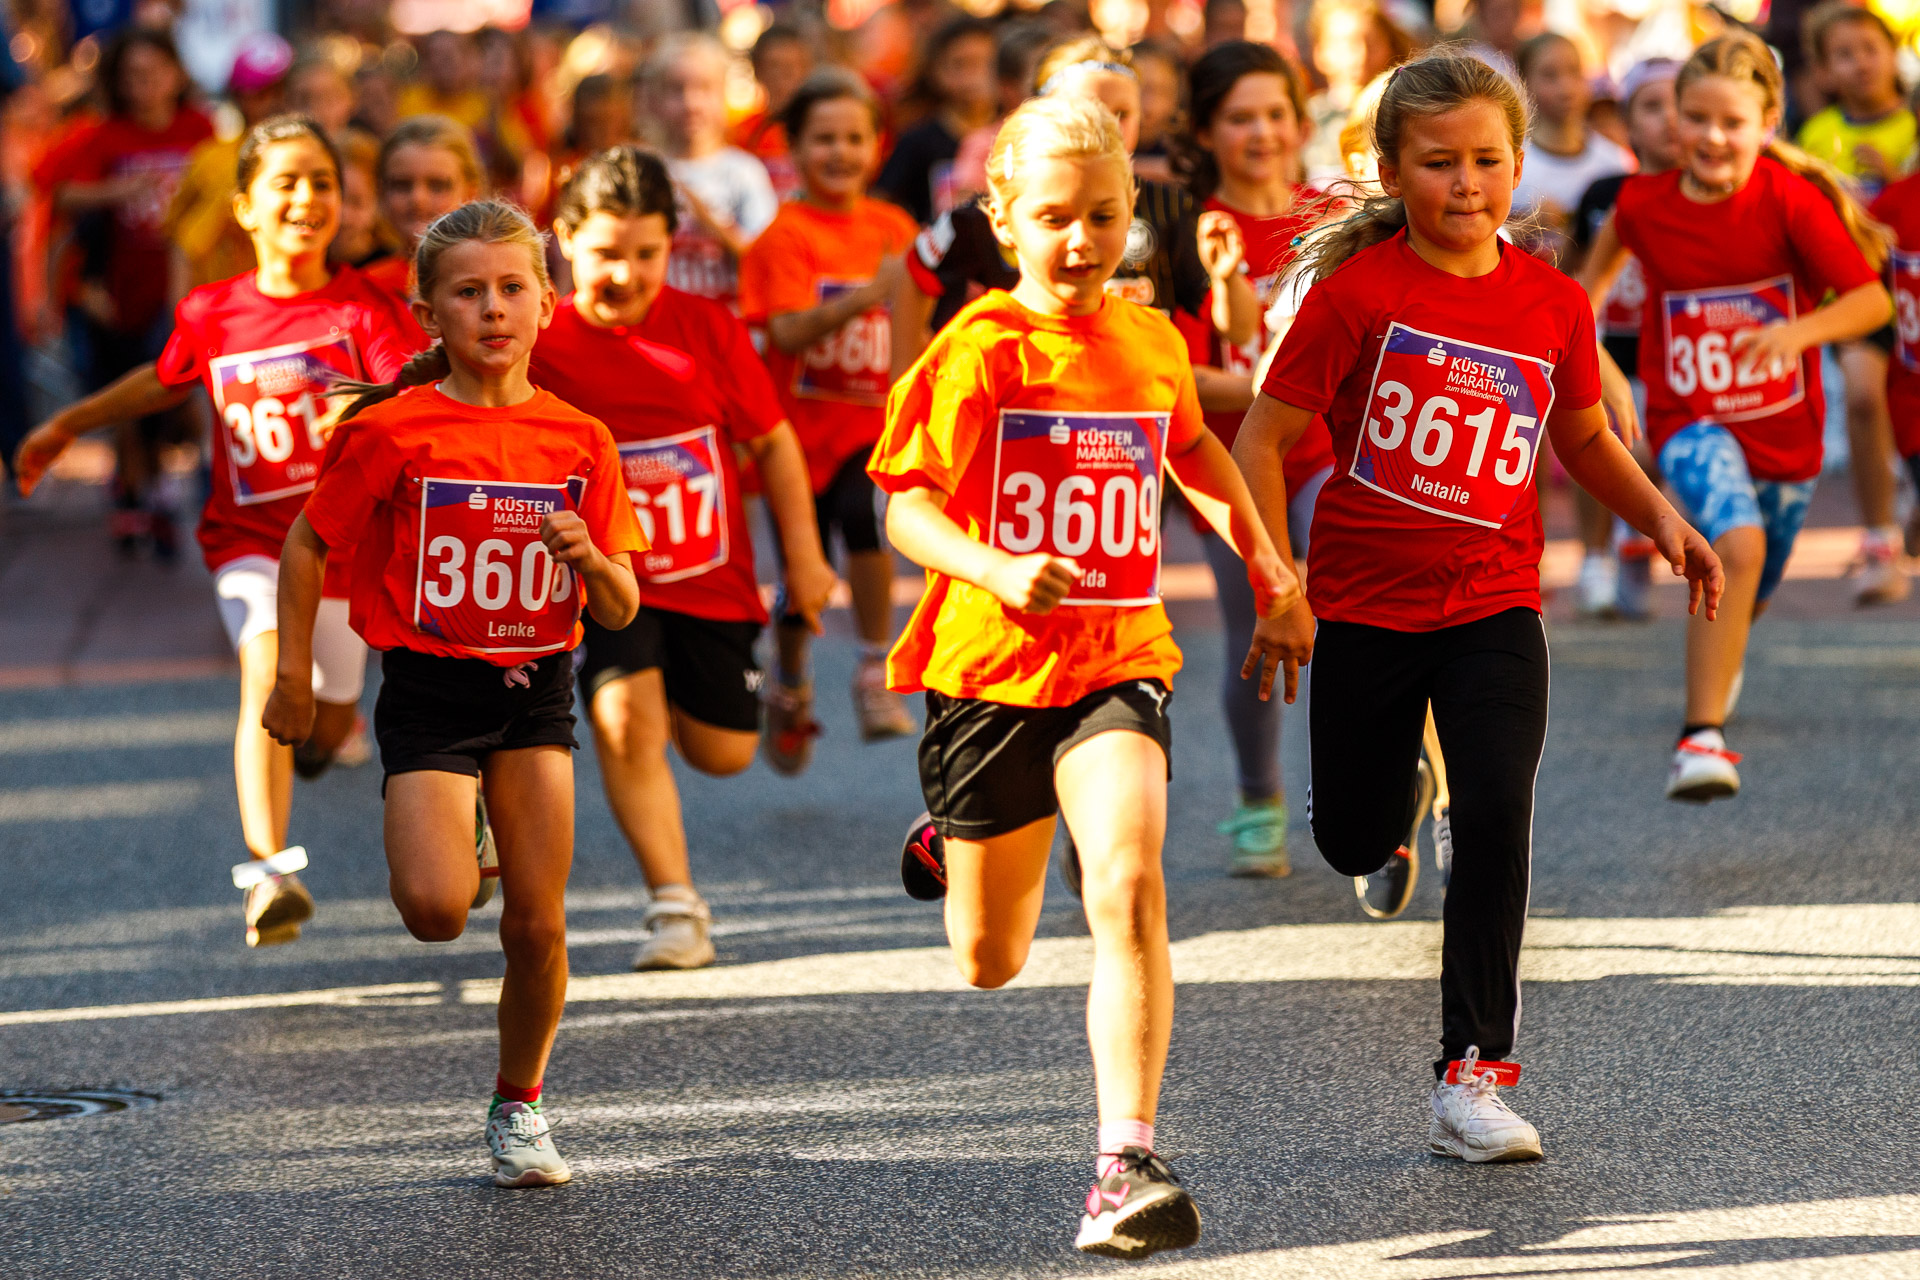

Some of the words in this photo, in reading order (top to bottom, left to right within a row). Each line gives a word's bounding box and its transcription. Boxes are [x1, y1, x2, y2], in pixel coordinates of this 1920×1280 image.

[1451, 356, 1507, 381] KÜSTEN
[1668, 329, 1787, 397] 362
[1444, 384, 1460, 393] zum
[1460, 386, 1504, 405] Weltkindertag
[1446, 371, 1519, 398] MARATHON
[224, 391, 329, 468] 361
[1077, 427, 1133, 446] KÜSTEN
[1368, 380, 1538, 486] 3615
[1076, 445, 1145, 461] MARATHON
[1411, 473, 1470, 505] Natalie
[494, 496, 555, 513] KÜSTEN
[627, 472, 718, 546] 617
[998, 471, 1157, 557] 3609
[493, 512, 545, 526] MARAT
[488, 621, 536, 638] Lenke
